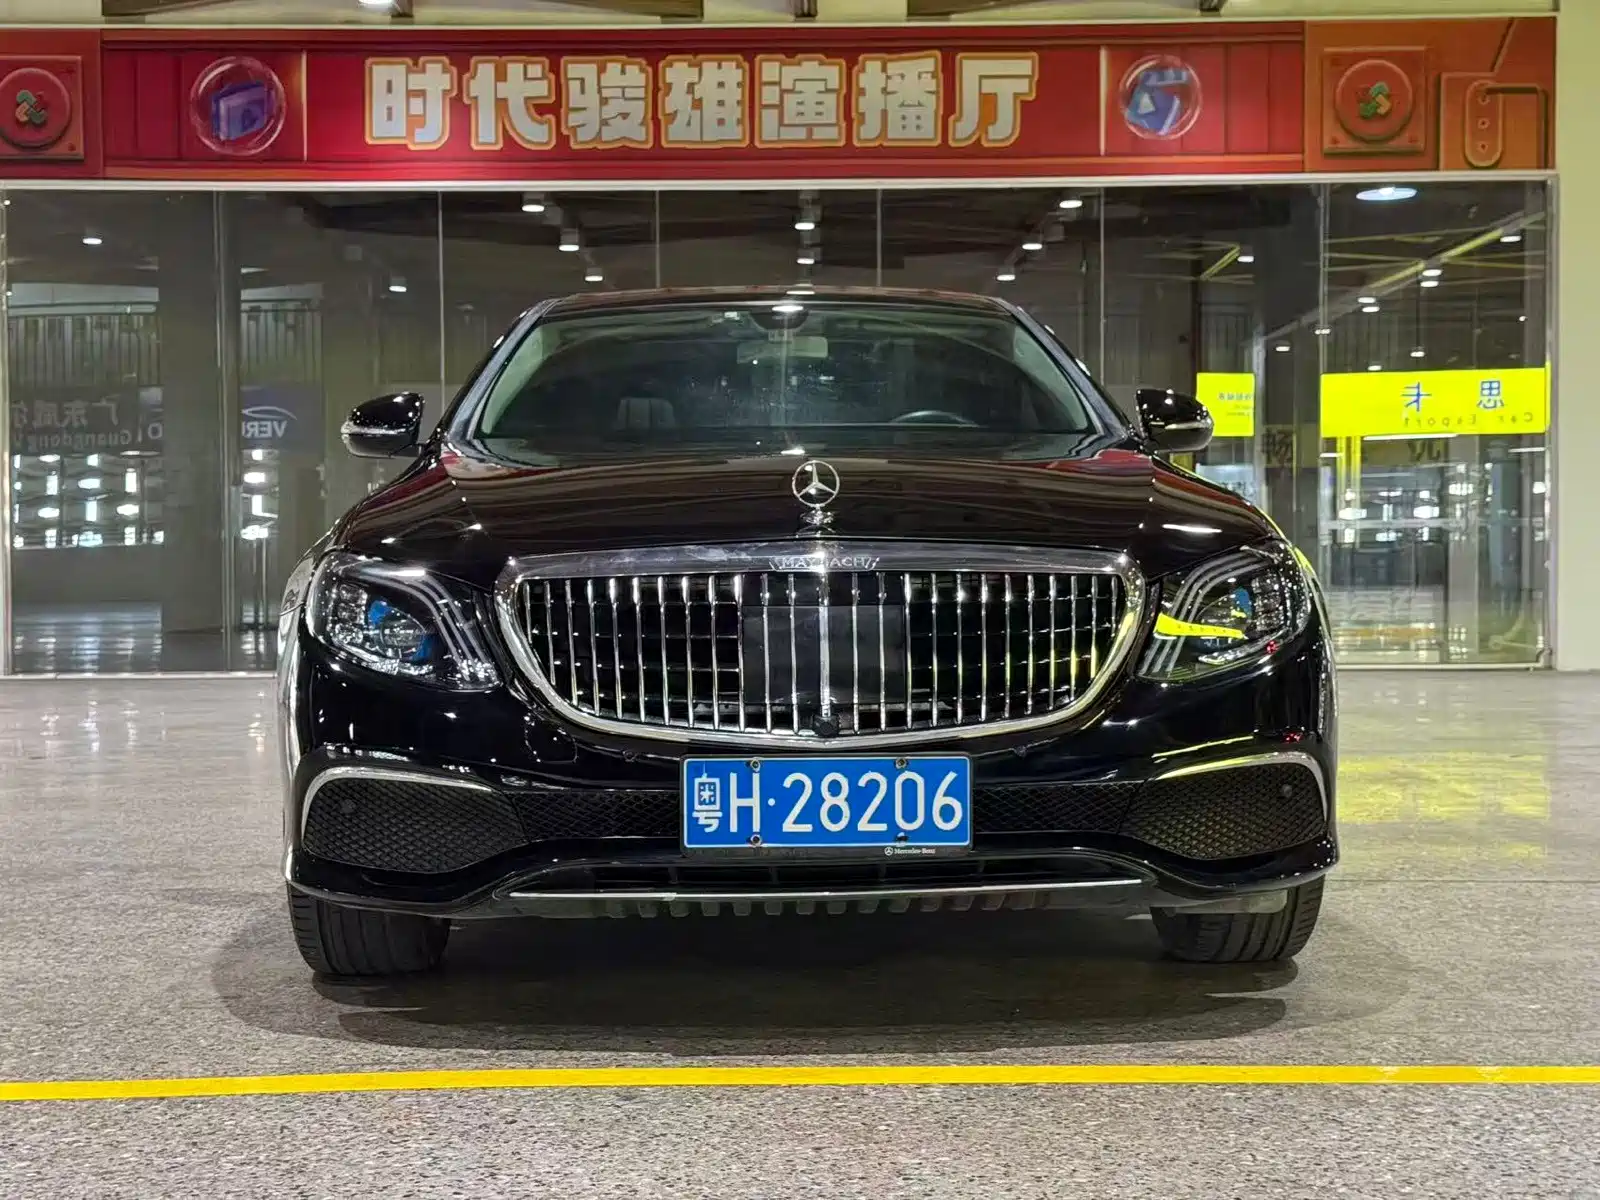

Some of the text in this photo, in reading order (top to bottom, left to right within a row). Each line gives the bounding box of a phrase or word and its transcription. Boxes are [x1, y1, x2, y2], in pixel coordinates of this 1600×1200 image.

[365, 50, 1040, 150] 时代骏雄演播厅
[692, 767, 963, 833] 粤H·28206
